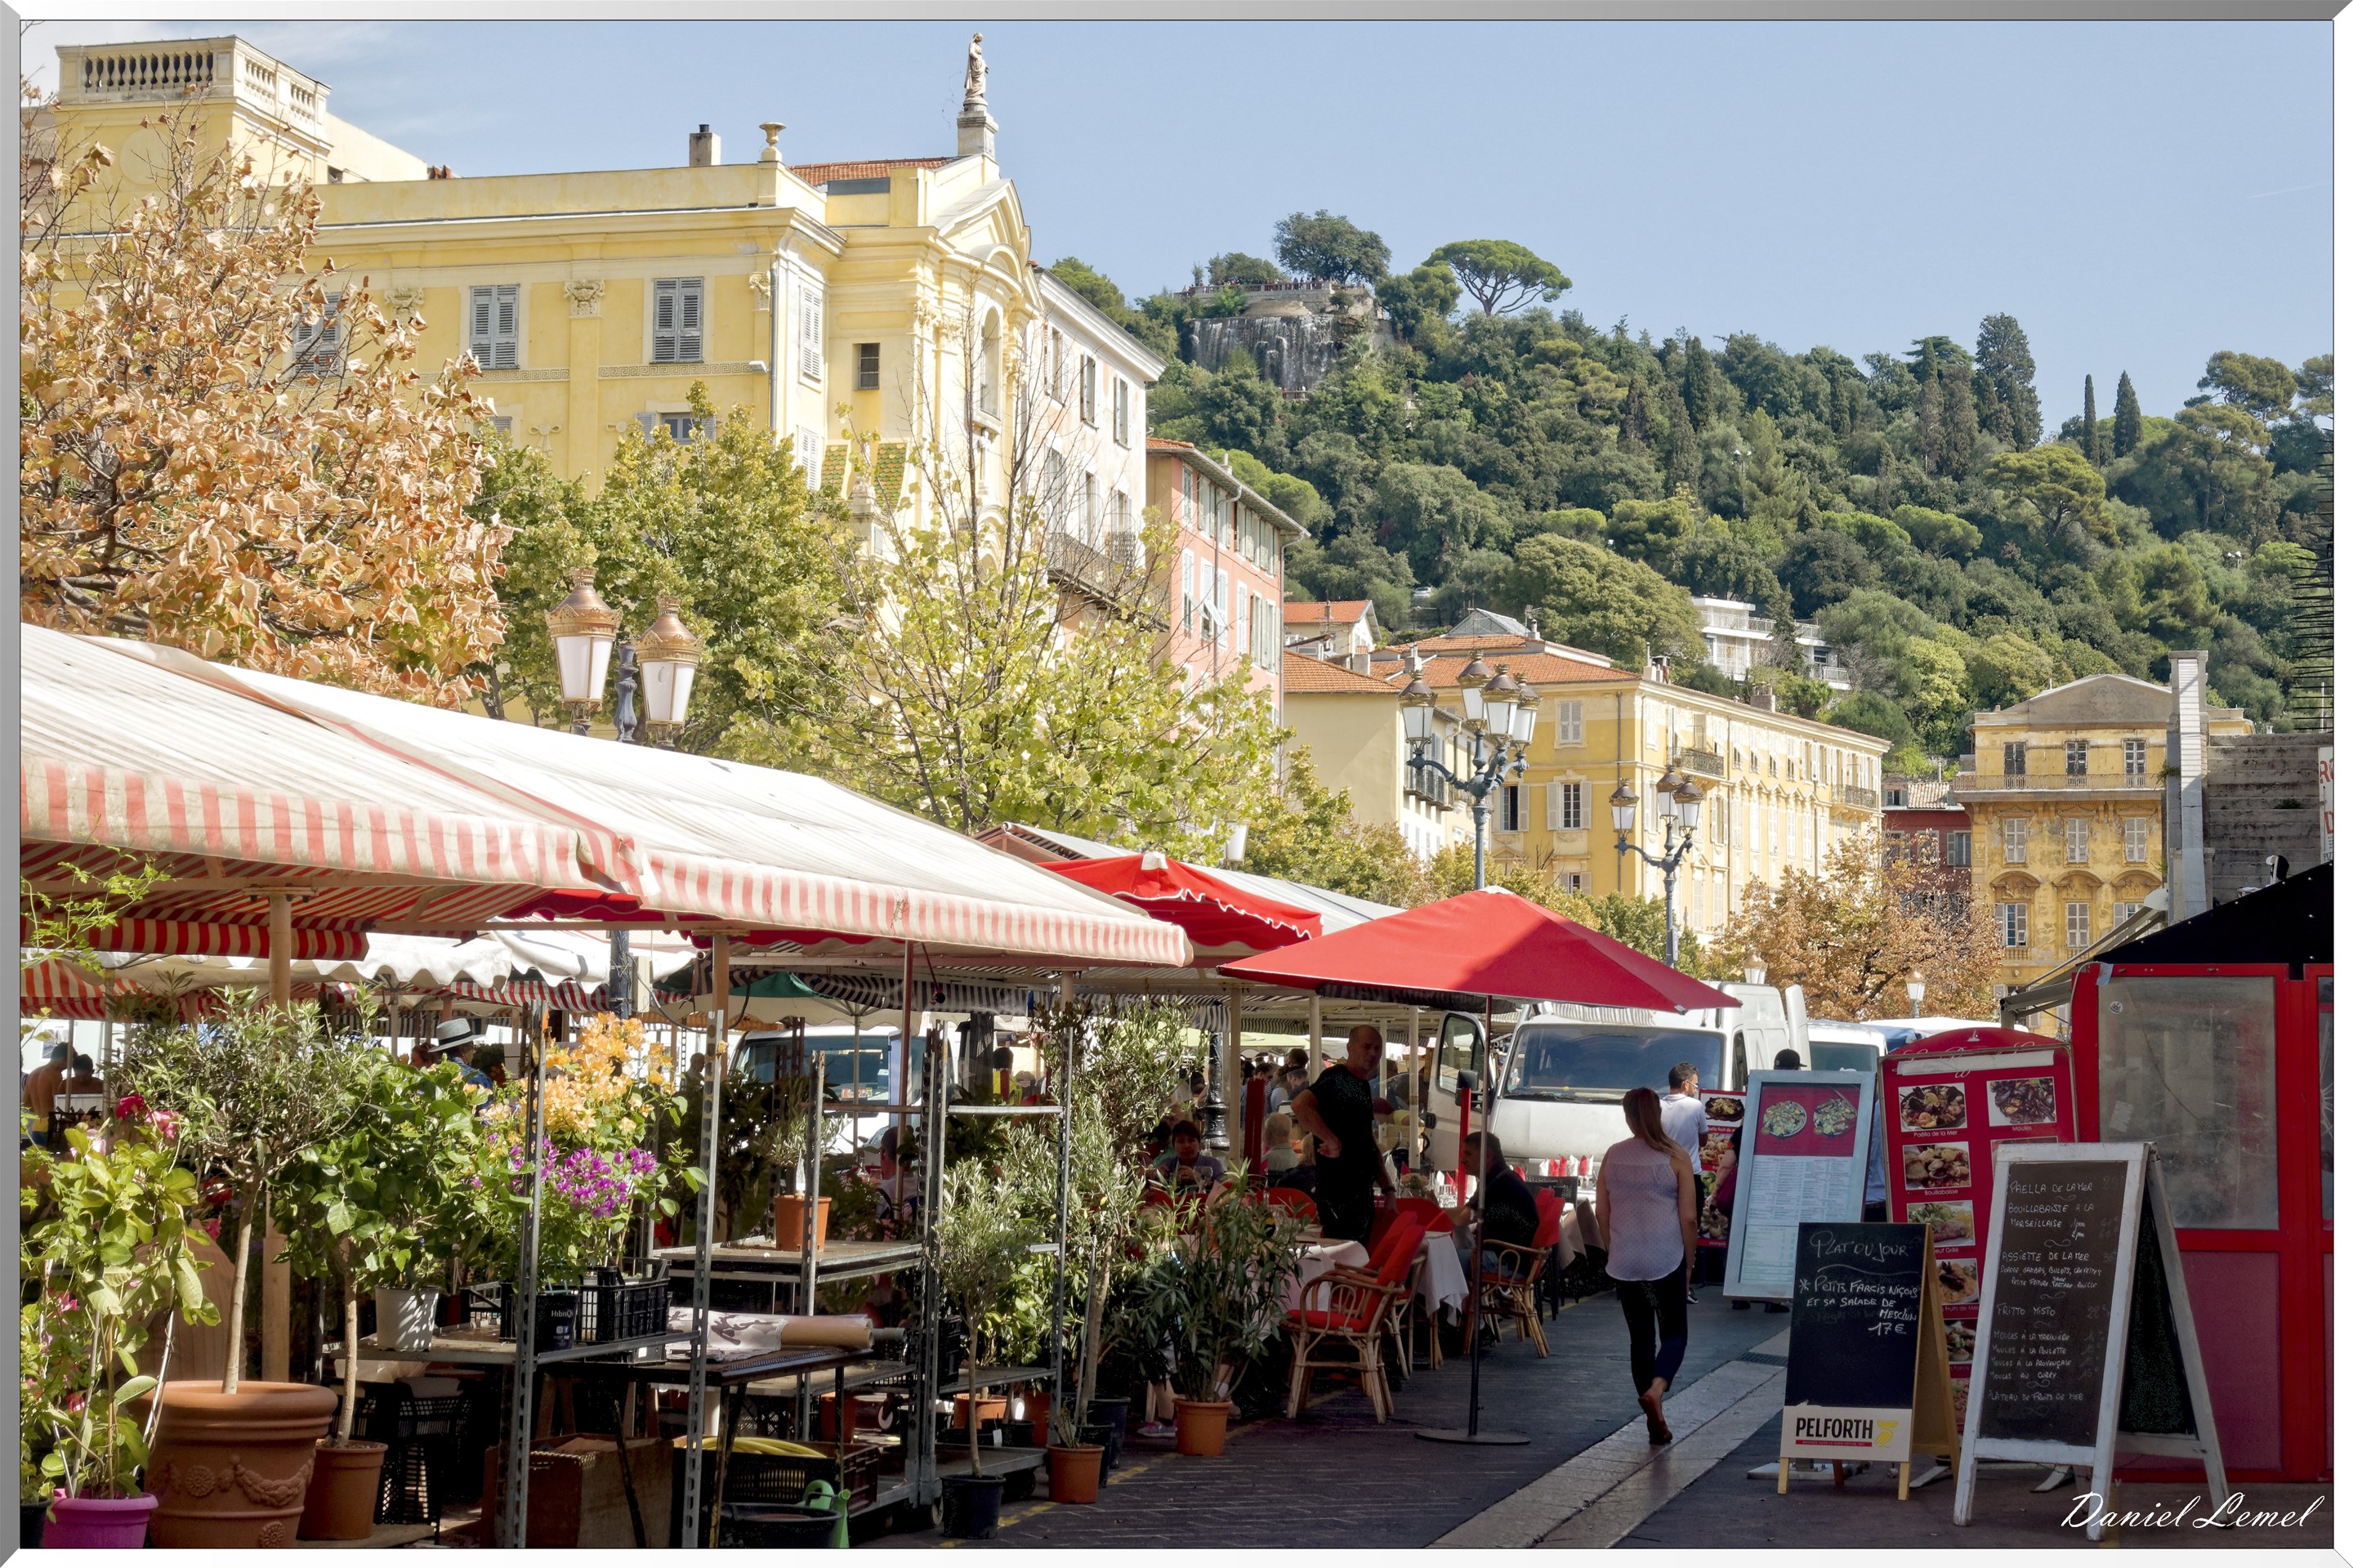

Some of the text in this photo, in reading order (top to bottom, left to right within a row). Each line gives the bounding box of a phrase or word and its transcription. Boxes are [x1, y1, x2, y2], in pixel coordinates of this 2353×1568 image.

[2010, 1181, 2047, 1195] PAELLA
[2052, 1184, 2063, 1192] DE
[2008, 1203, 2069, 1213] BOUILLABAISSE
[2084, 1204, 2095, 1213] LA
[2011, 1218, 2063, 1228] MARSEILLAISE
[1810, 1231, 1909, 1262] PLAT DU JOUR
[2002, 1250, 2042, 1262] ASSIETTE
[2048, 1252, 2058, 1260] DE
[2075, 1252, 2090, 1261] MER
[1850, 1280, 1886, 1294] FARCIS
[1806, 1297, 1896, 1307] ET SA SALADE DE
[1996, 1302, 2026, 1316] FRITTO
[2033, 1307, 2056, 1316] MISTO
[1796, 1418, 1873, 1439] PELFORTH
